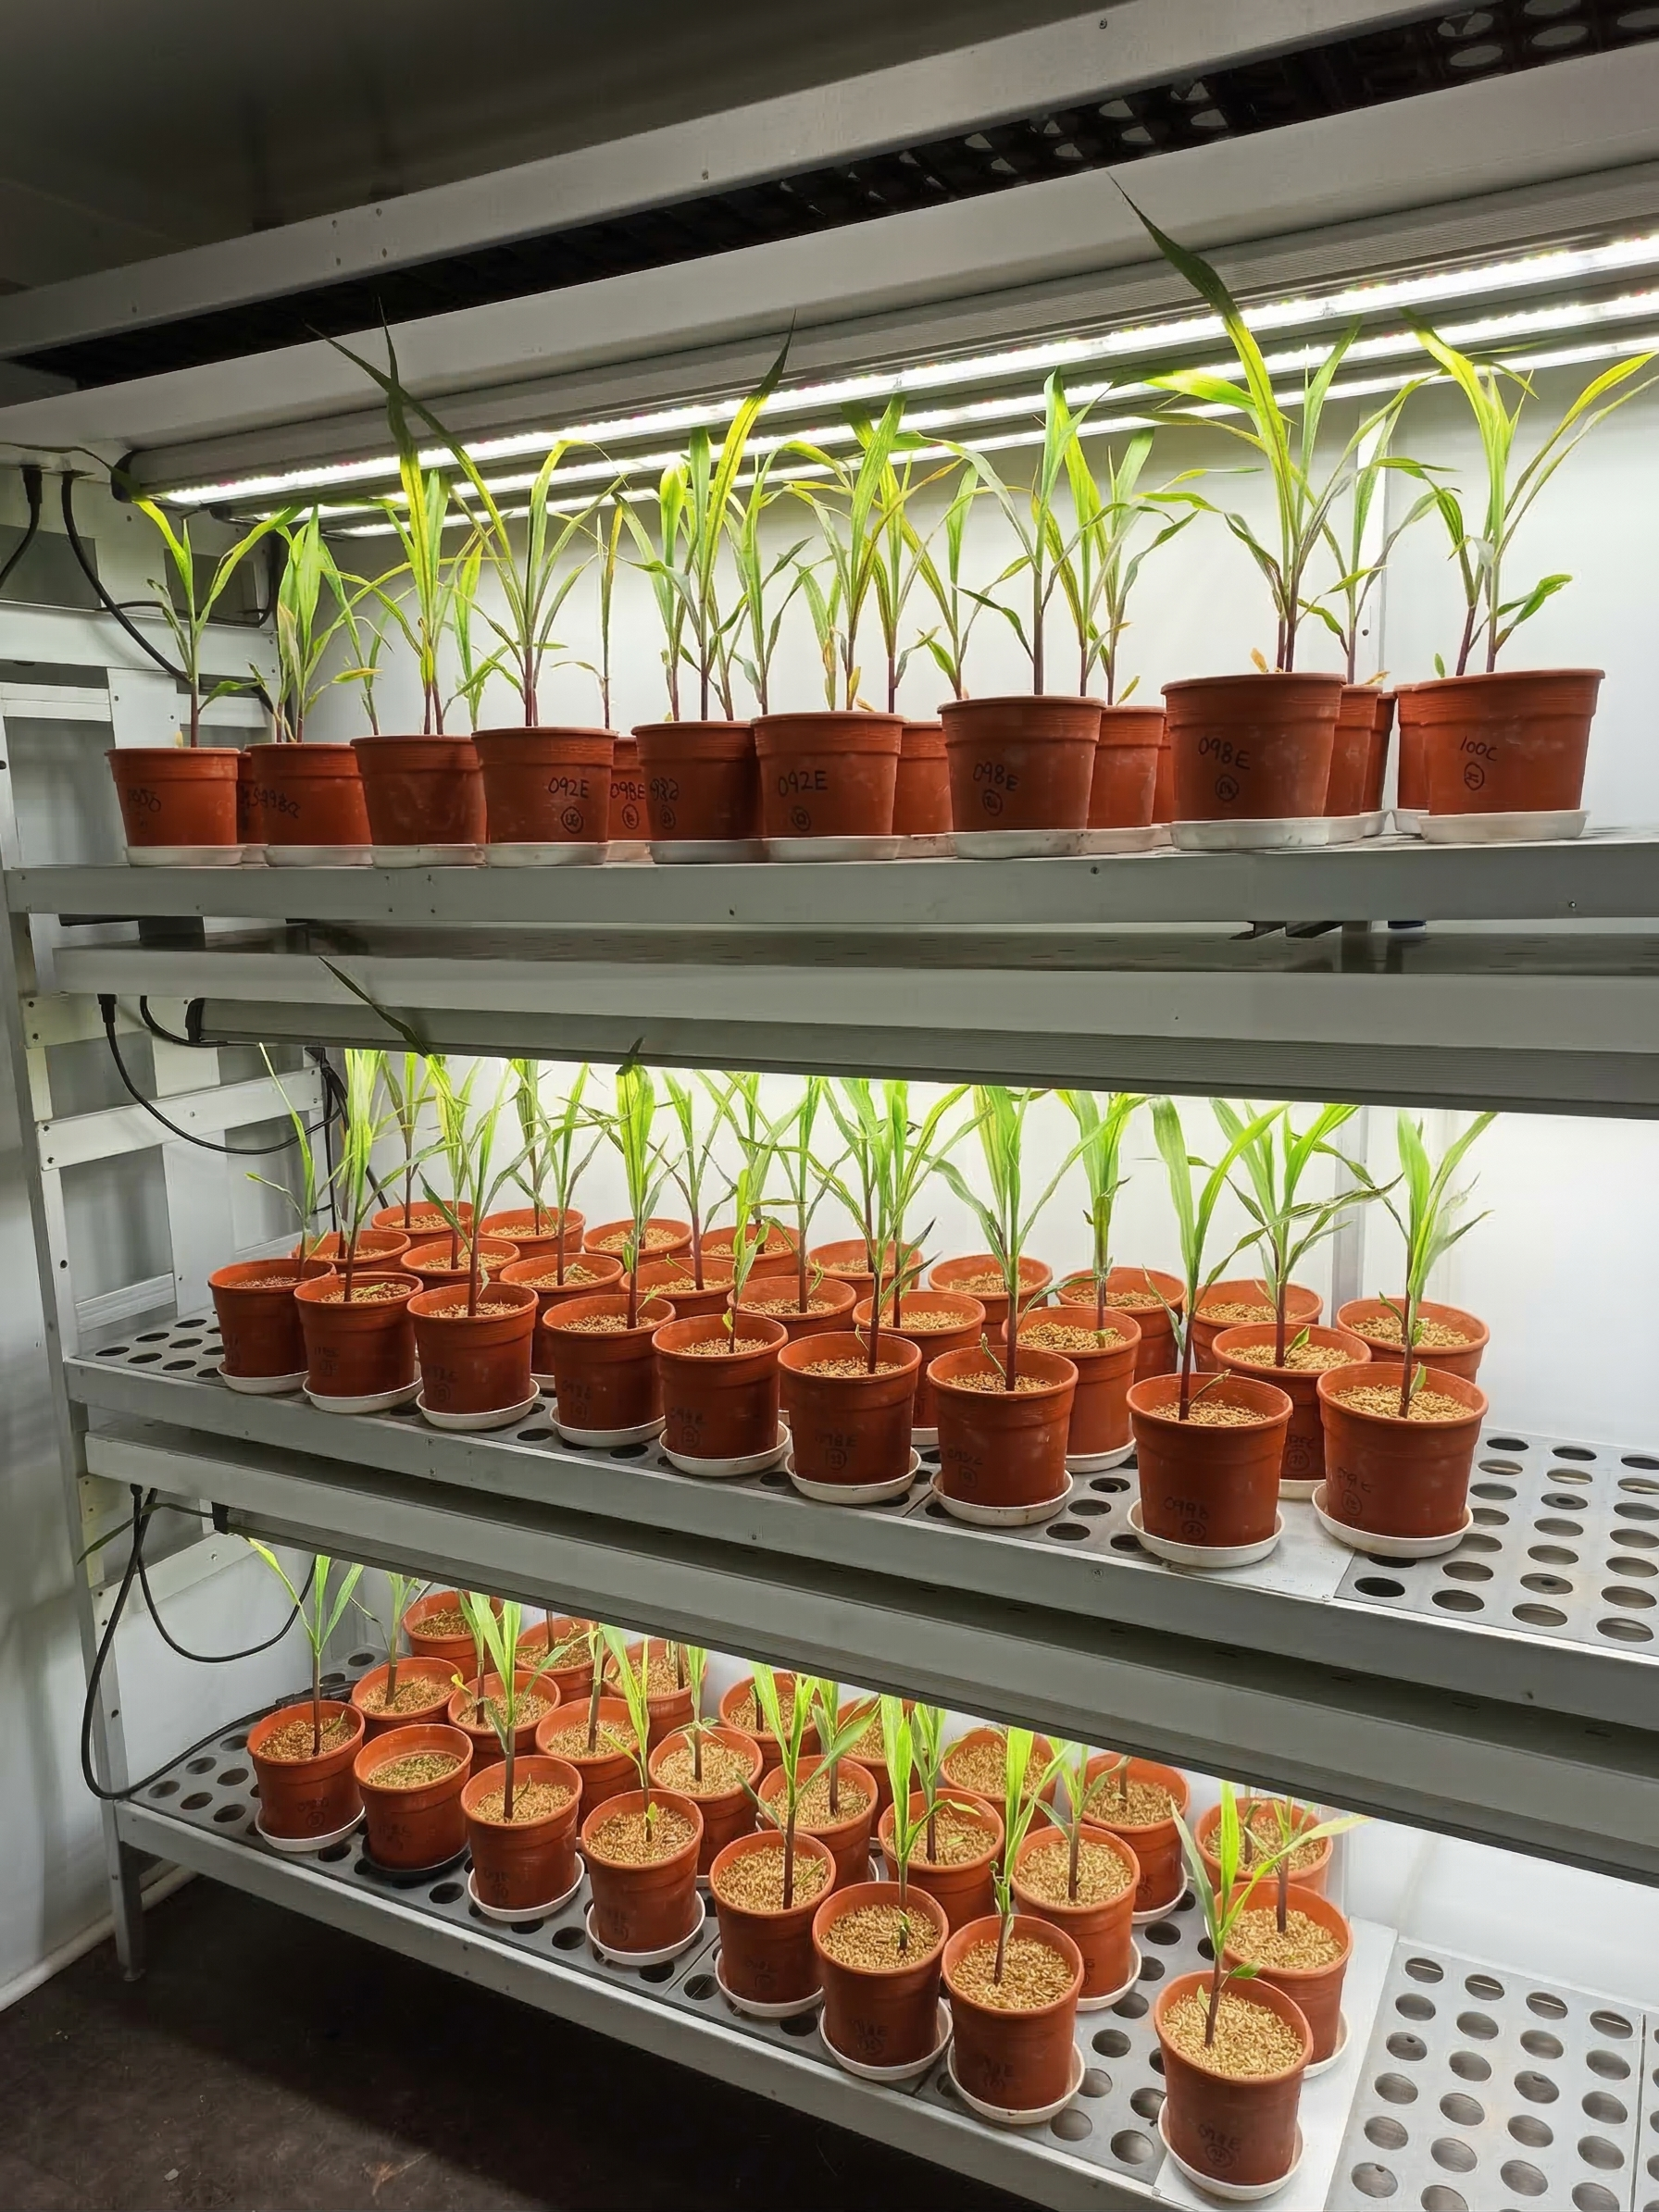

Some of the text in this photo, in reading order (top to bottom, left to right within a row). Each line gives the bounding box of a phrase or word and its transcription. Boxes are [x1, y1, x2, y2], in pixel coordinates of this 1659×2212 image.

[1198, 737, 1250, 770] 098E
[1460, 736, 1498, 762] 100C
[548, 777, 589, 799] 092E
[778, 770, 828, 797] 092E
[973, 761, 1019, 791] 098E
